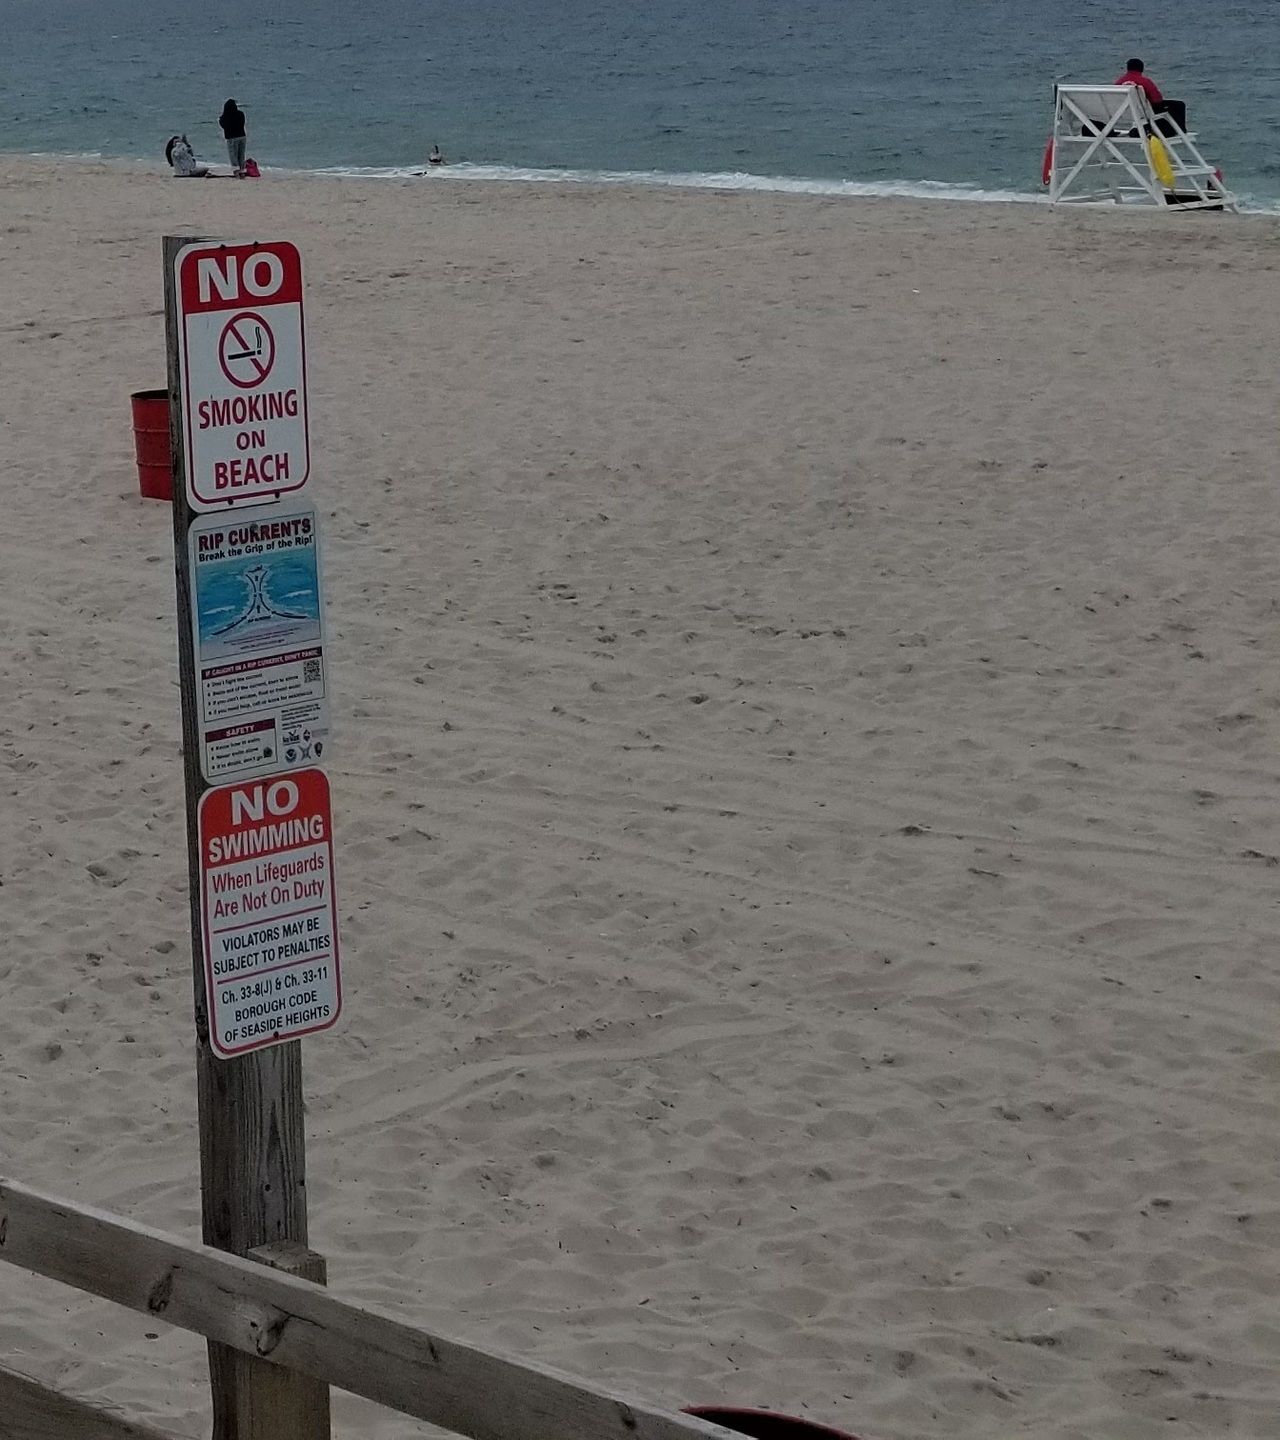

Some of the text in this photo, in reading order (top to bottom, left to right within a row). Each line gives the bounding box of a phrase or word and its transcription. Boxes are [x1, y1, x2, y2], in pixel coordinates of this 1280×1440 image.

[197, 251, 284, 303] NO
[198, 389, 298, 430] SMOKING
[236, 429, 266, 451] ON
[214, 452, 289, 490] BEACH
[199, 518, 311, 552] RIP CURRENTS
[199, 550, 226, 562] Break
[228, 547, 242, 557] the
[245, 543, 264, 554] Grip
[266, 541, 275, 550] of
[278, 539, 293, 548] the
[226, 725, 255, 737] SAFETY
[231, 780, 299, 826] NO
[208, 814, 324, 863] SWIMMING
[212, 851, 325, 894] When Lifeguards
[213, 879, 325, 919] Are Not On Duty
[222, 916, 320, 952] VIOLATORS MAY BE
[213, 934, 331, 975] SUBJECT TO PENALTIES
[222, 966, 328, 1005] Ch. 33-8(J) & Ch. 33-11
[224, 1004, 330, 1043] OF SEASIDE HEIGHTS
[235, 990, 318, 1022] BOROUGH CODE
